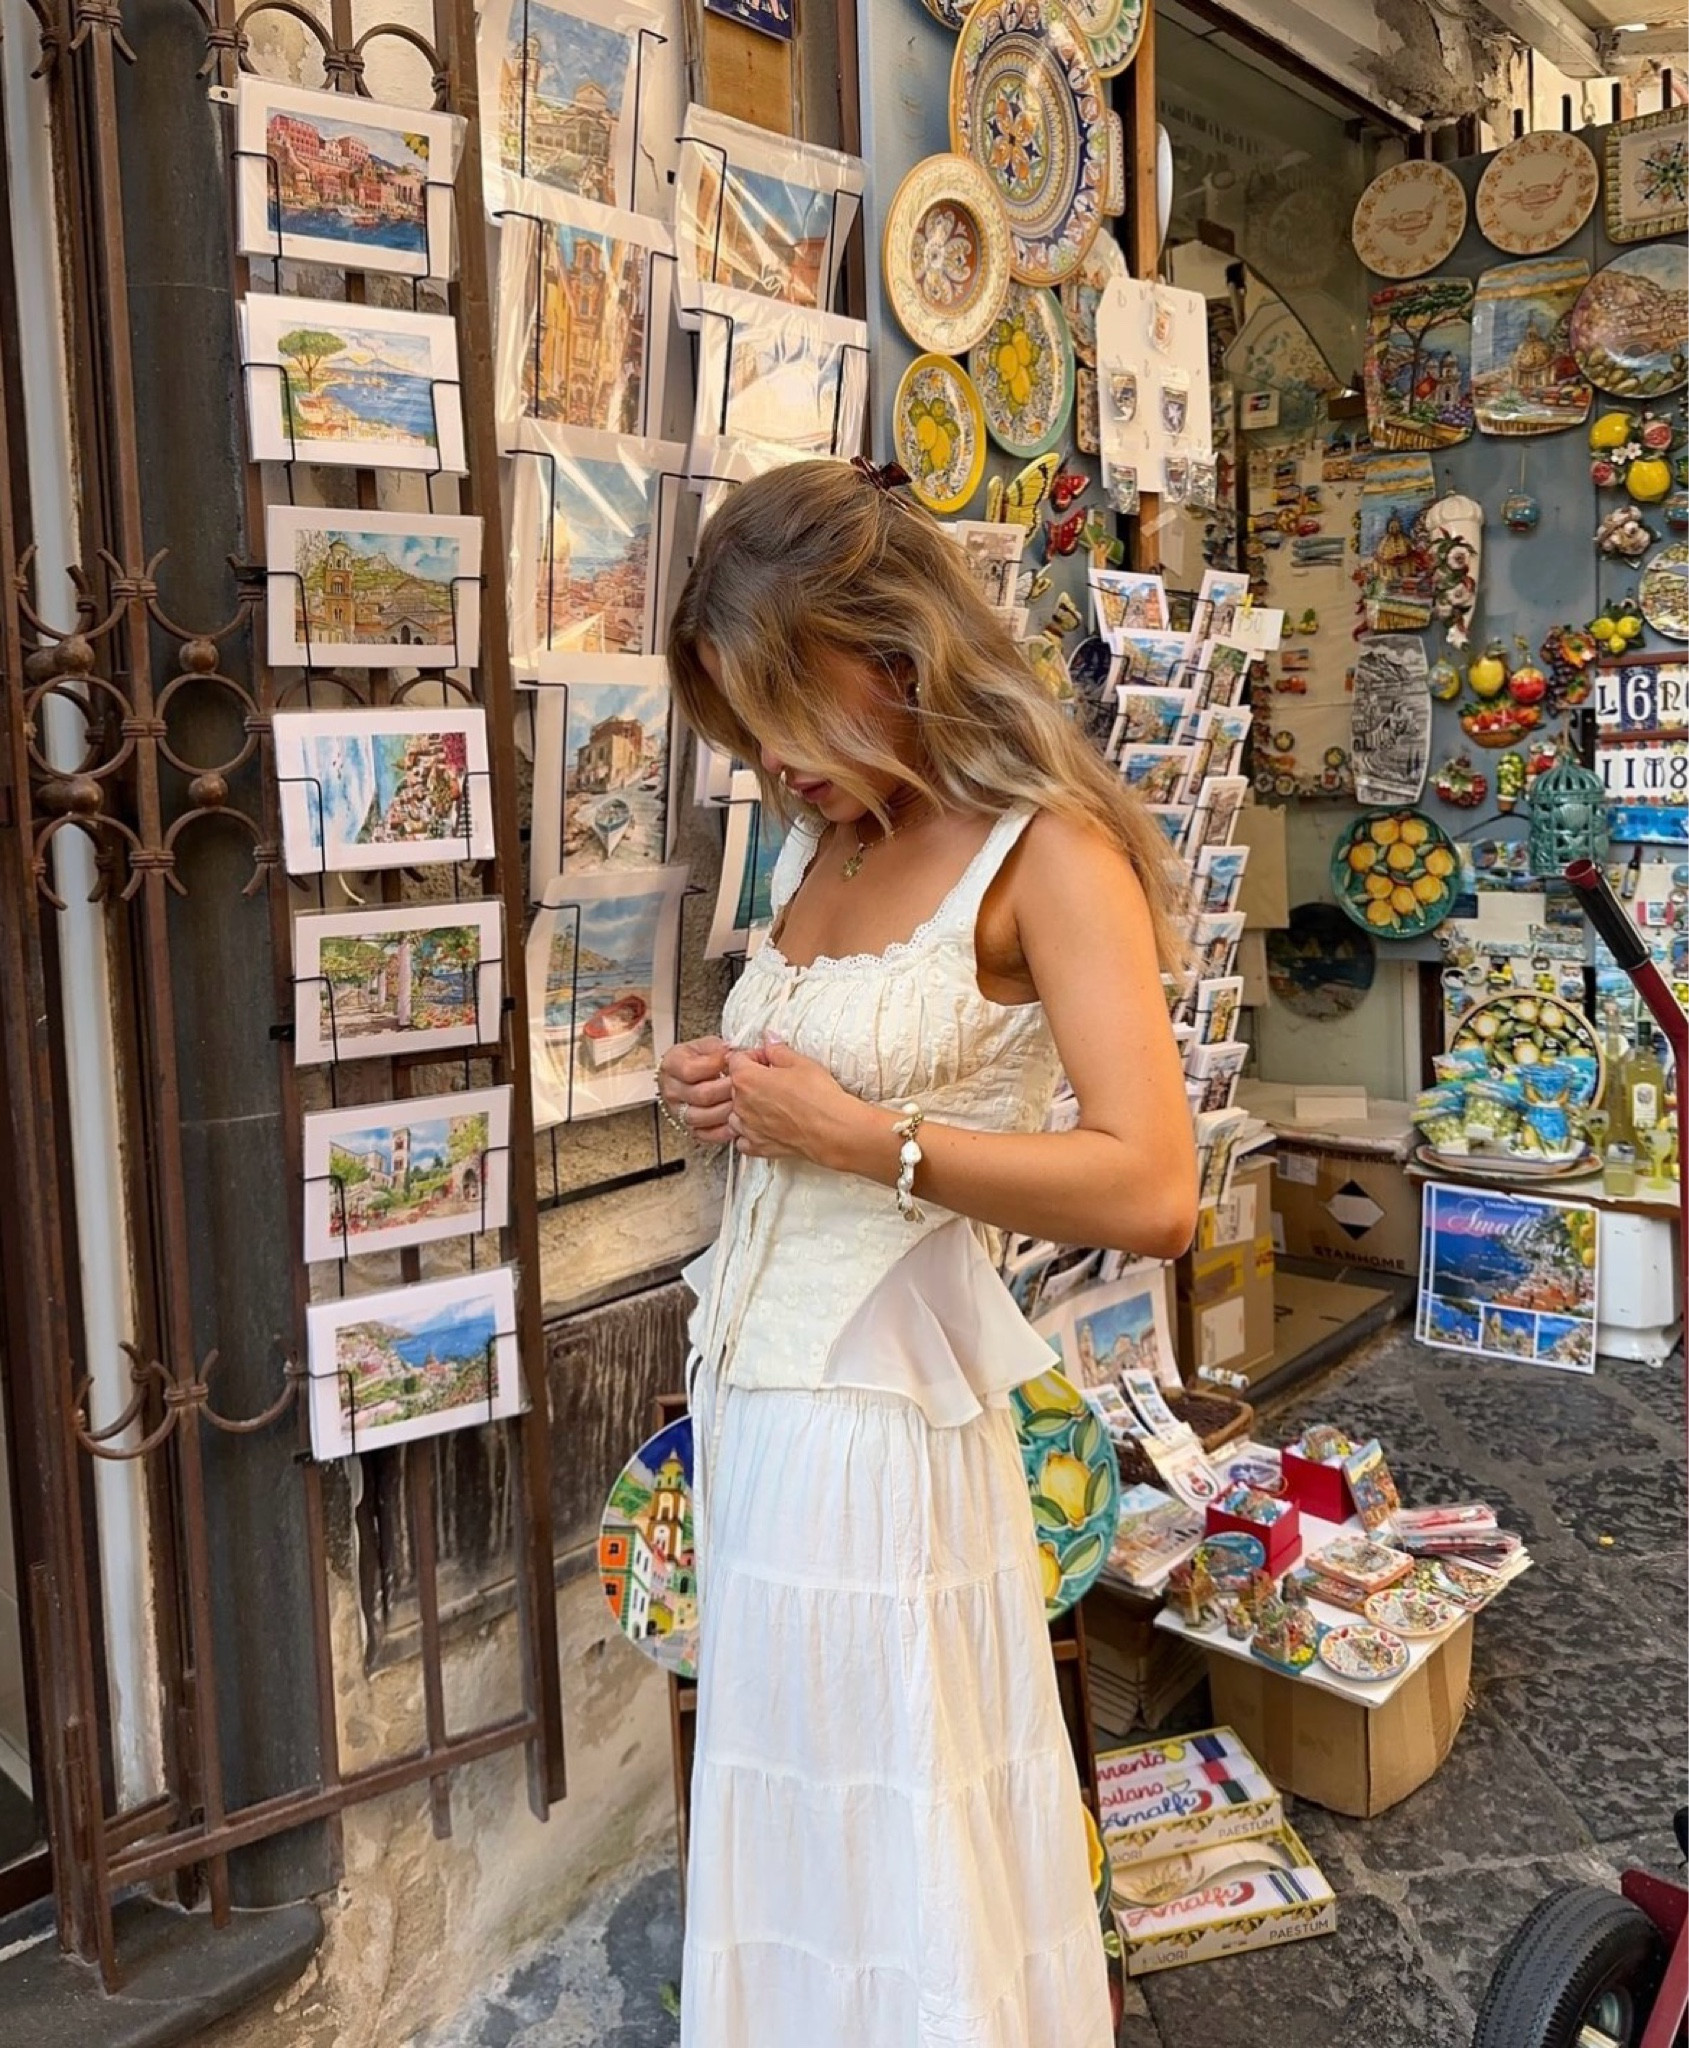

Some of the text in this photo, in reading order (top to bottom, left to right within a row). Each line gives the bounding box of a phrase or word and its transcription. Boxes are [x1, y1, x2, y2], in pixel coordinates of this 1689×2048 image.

[1312, 1245, 1405, 1270] STANHOME
[1101, 1793, 1197, 1834] Amalfi
[1219, 1818, 1275, 1838] PAESTUM
[1270, 1920, 1329, 1940] PAESTUM
